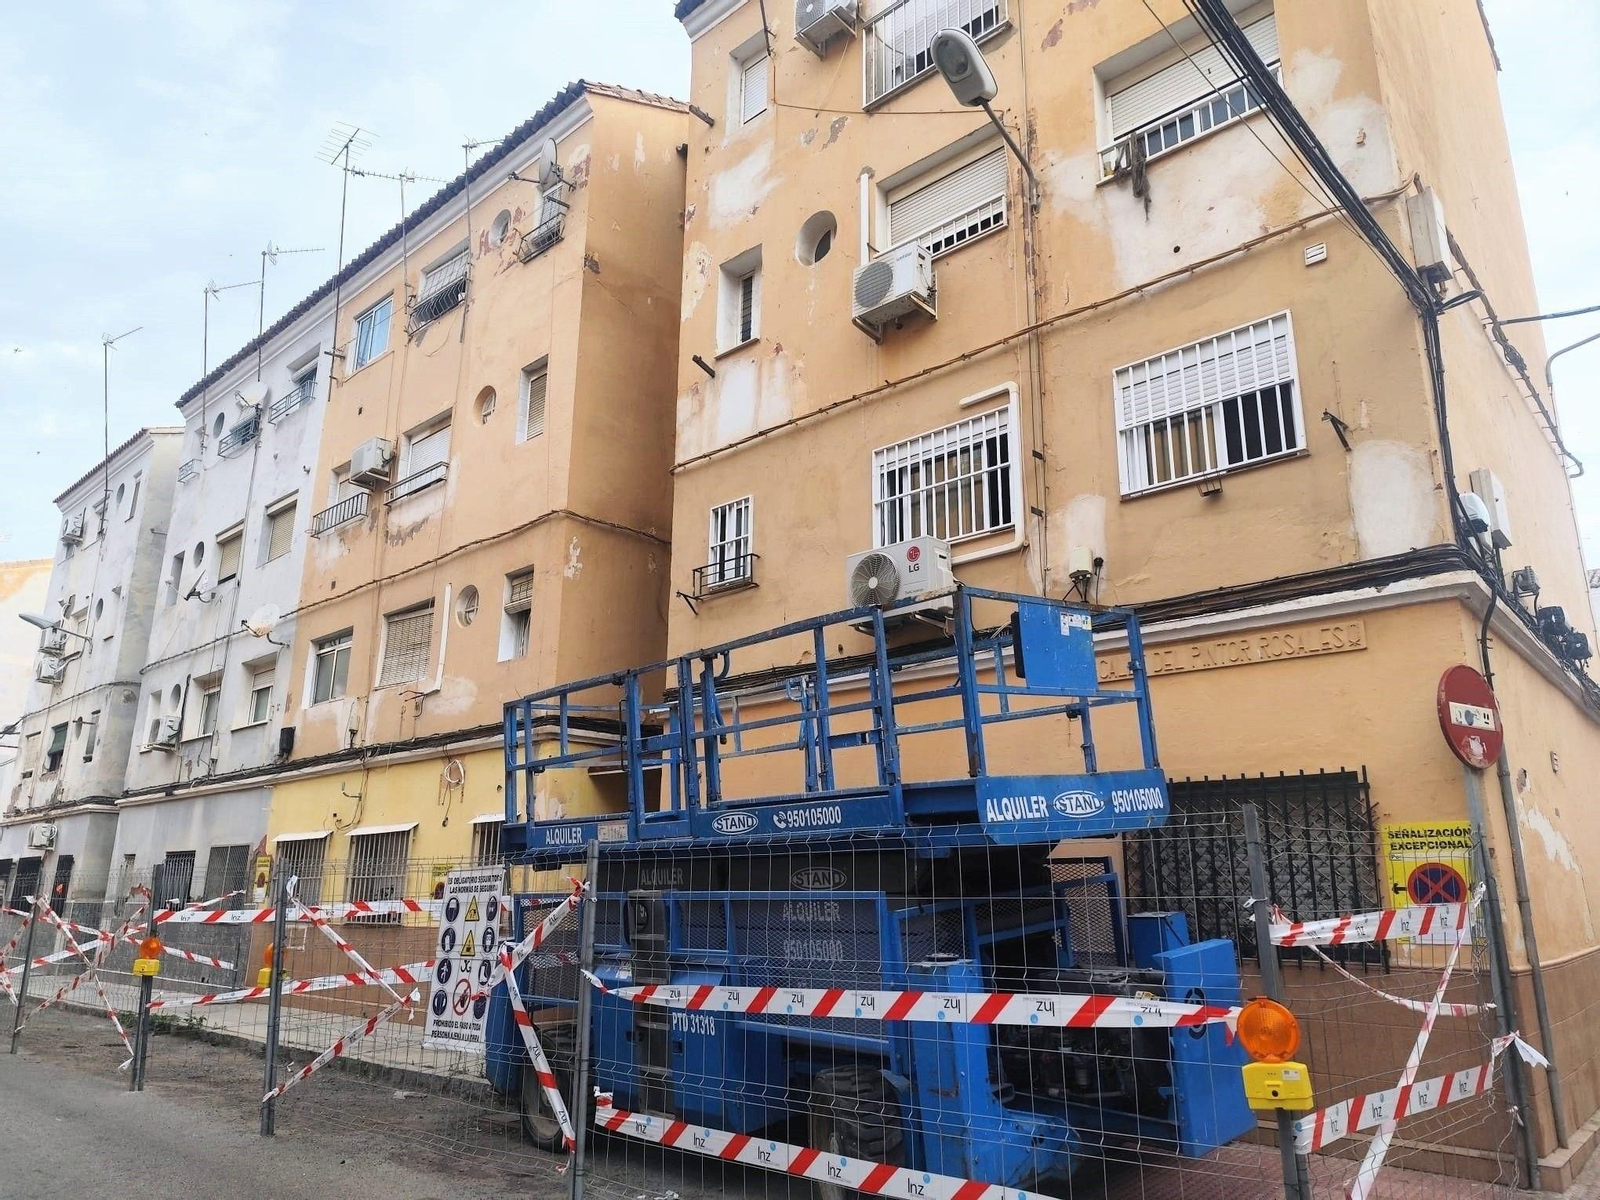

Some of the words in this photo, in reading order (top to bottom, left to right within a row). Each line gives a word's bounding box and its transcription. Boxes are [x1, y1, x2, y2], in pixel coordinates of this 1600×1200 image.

[908, 563, 920, 573] LG
[1100, 656, 1139, 679] CAL
[1153, 650, 1185, 674] DEL
[1259, 626, 1344, 660] ROSALES
[986, 795, 1050, 823] ALQUILER
[1056, 792, 1104, 814] STAND
[1111, 787, 1164, 814] 950105000
[715, 814, 756, 832] STAND
[787, 806, 842, 828] 950105000
[545, 827, 582, 844] ALQUILER
[1388, 827, 1471, 839] SEÑALIZACIÓN
[1390, 840, 1471, 851] EXCEPCIONAL
[641, 868, 684, 885] ALQUILER
[795, 870, 843, 887] STAND
[783, 902, 841, 921] ALQUILER
[672, 1012, 688, 1032] PTD
[690, 1014, 715, 1036] 31318
